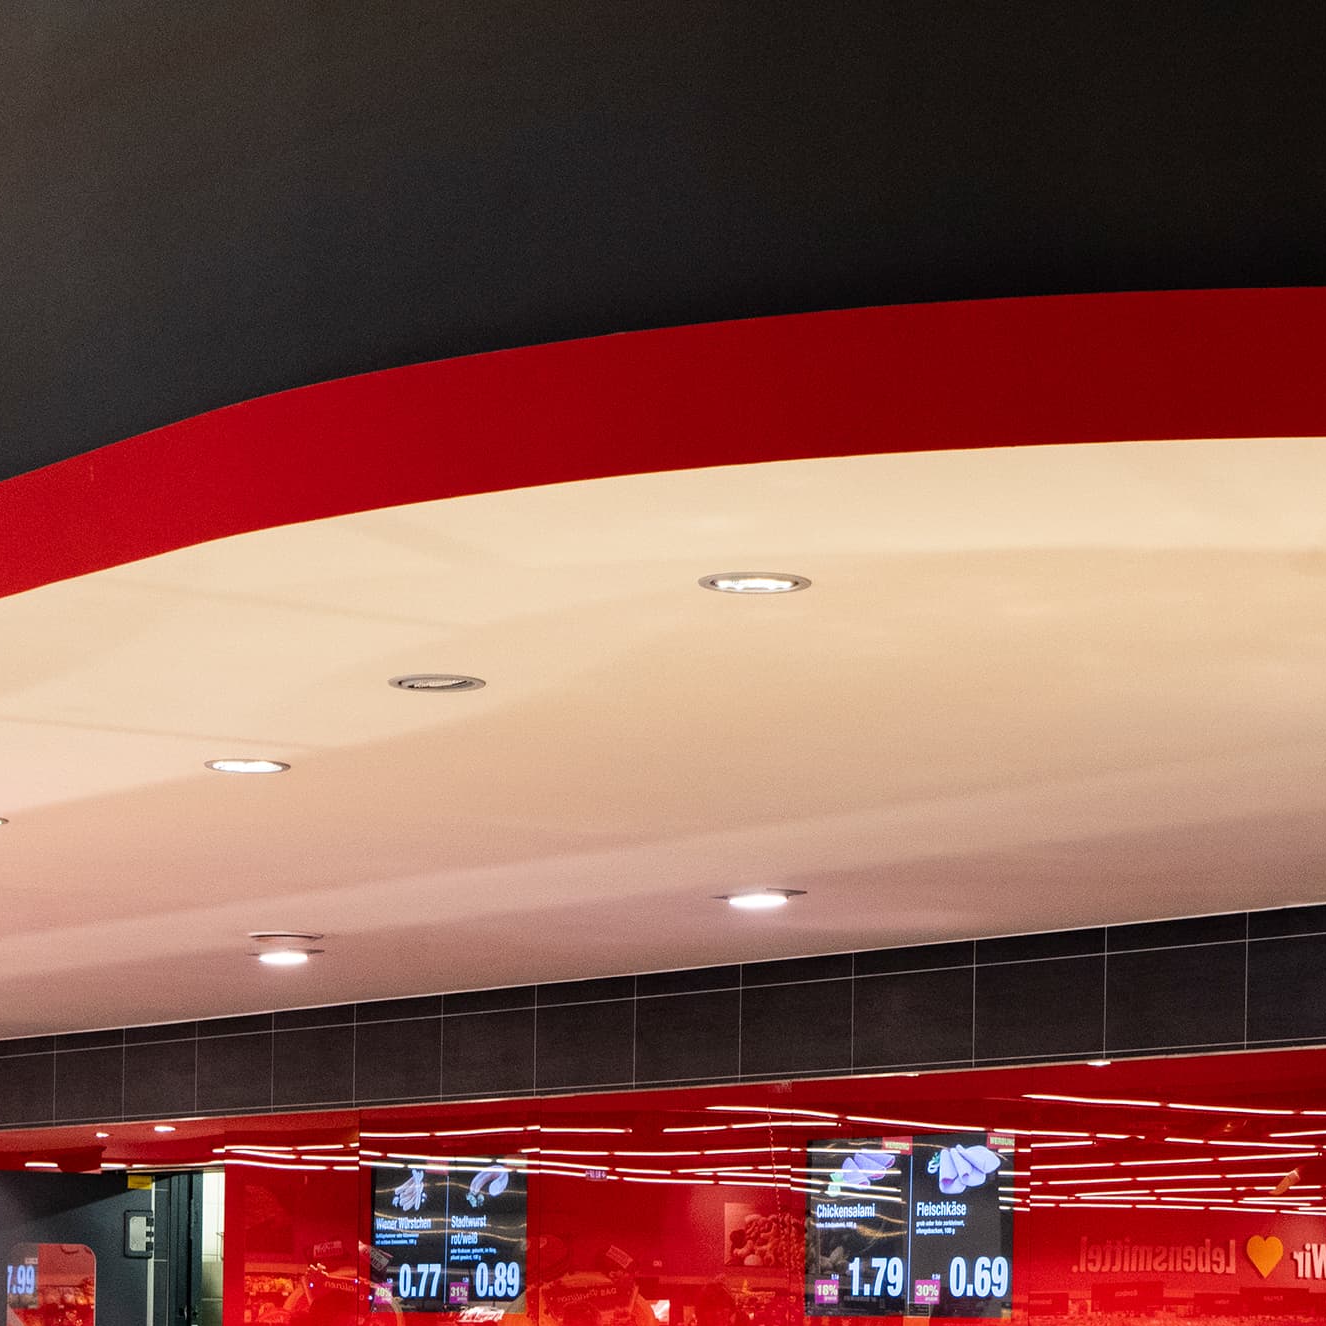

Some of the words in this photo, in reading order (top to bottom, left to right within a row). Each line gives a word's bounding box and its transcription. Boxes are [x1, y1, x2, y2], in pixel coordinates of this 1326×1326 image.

[816, 1203, 875, 1218] Chickensalami
[916, 1201, 967, 1216] Fleischkäse
[451, 1215, 487, 1228] Stadtwurst
[399, 1263, 442, 1298] 0.77
[476, 1262, 520, 1297] 0.89
[849, 1256, 903, 1297] 1.79
[949, 1256, 1009, 1297] 0.69
[450, 1286, 468, 1297] 31%
[916, 1285, 939, 1297] 30%
